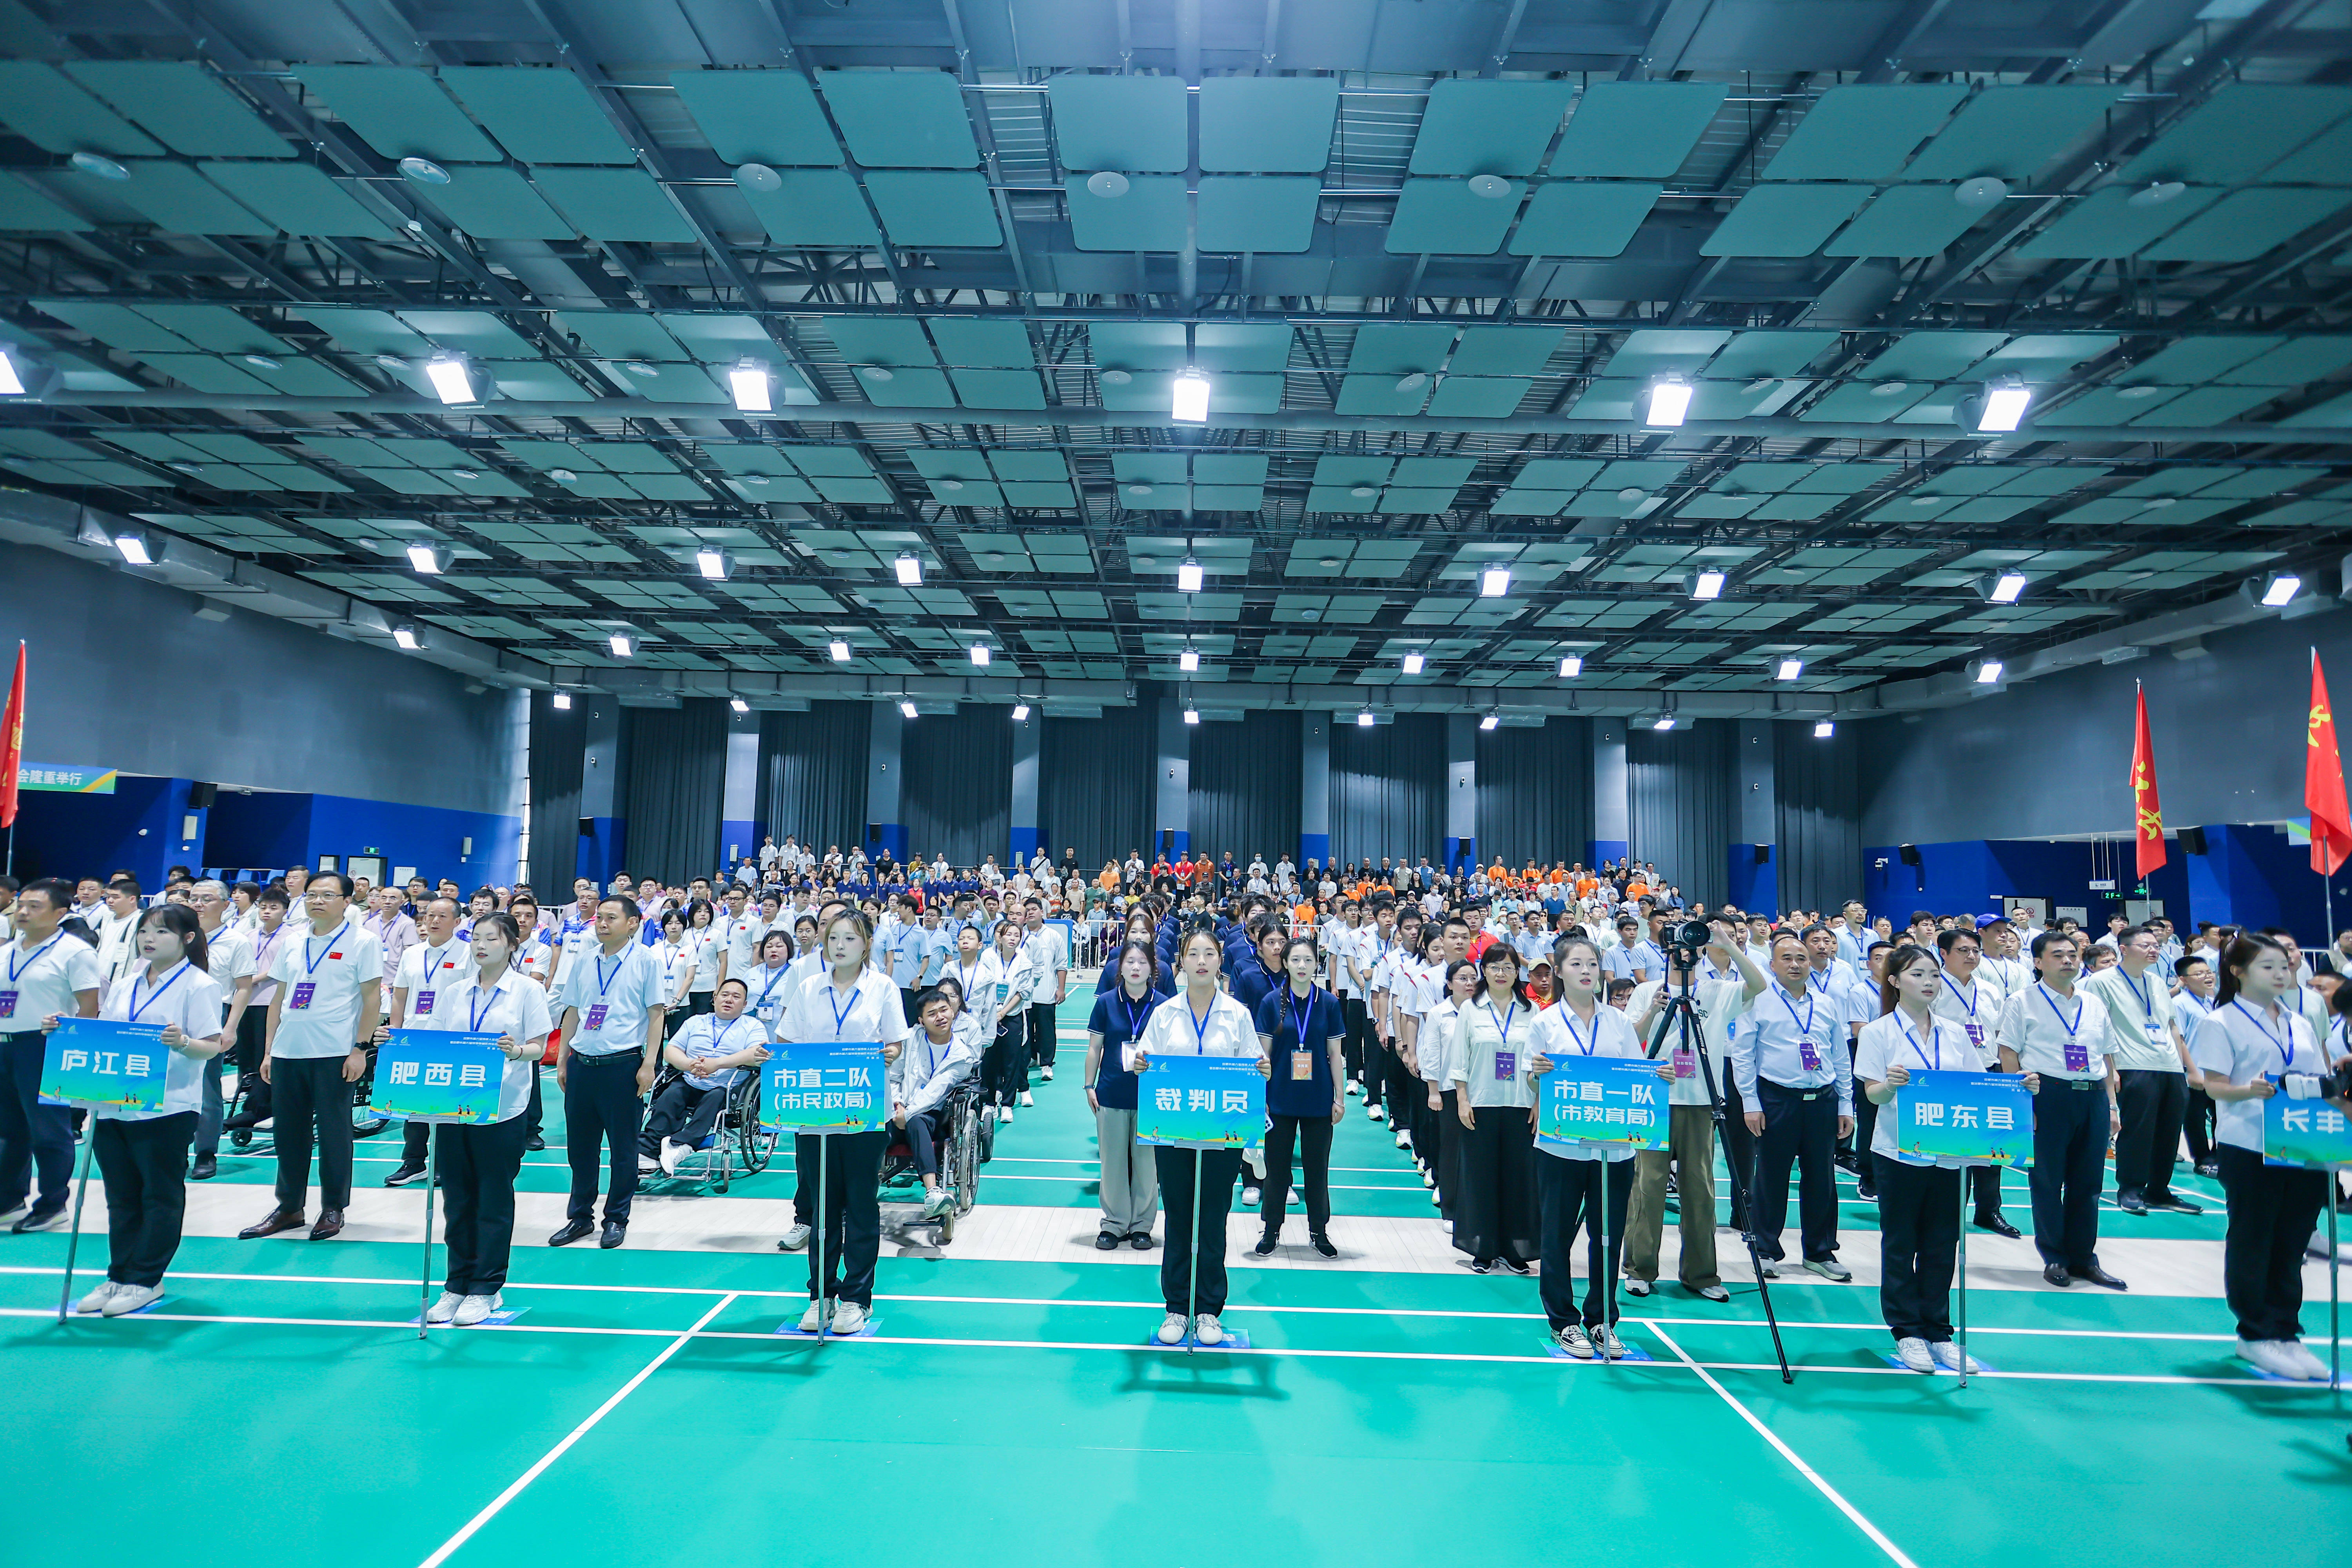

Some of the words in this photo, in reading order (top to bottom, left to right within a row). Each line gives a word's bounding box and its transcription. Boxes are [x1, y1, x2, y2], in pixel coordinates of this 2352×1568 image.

[18, 769, 82, 785] 会隆重举行
[1696, 1024, 1705, 1047] Manfrotto
[60, 1050, 150, 1077] 庐江县
[389, 1062, 486, 1087] 肥西县
[774, 1067, 871, 1088] 市直二队
[774, 1092, 871, 1111] (市民政局)
[1155, 1088, 1248, 1113] 裁判员
[1554, 1080, 1655, 1105] 市直一队
[1554, 1104, 1655, 1127] (市教育局)
[1915, 1102, 2014, 1130] 肥东县
[2281, 1107, 2345, 1134] 长丰
